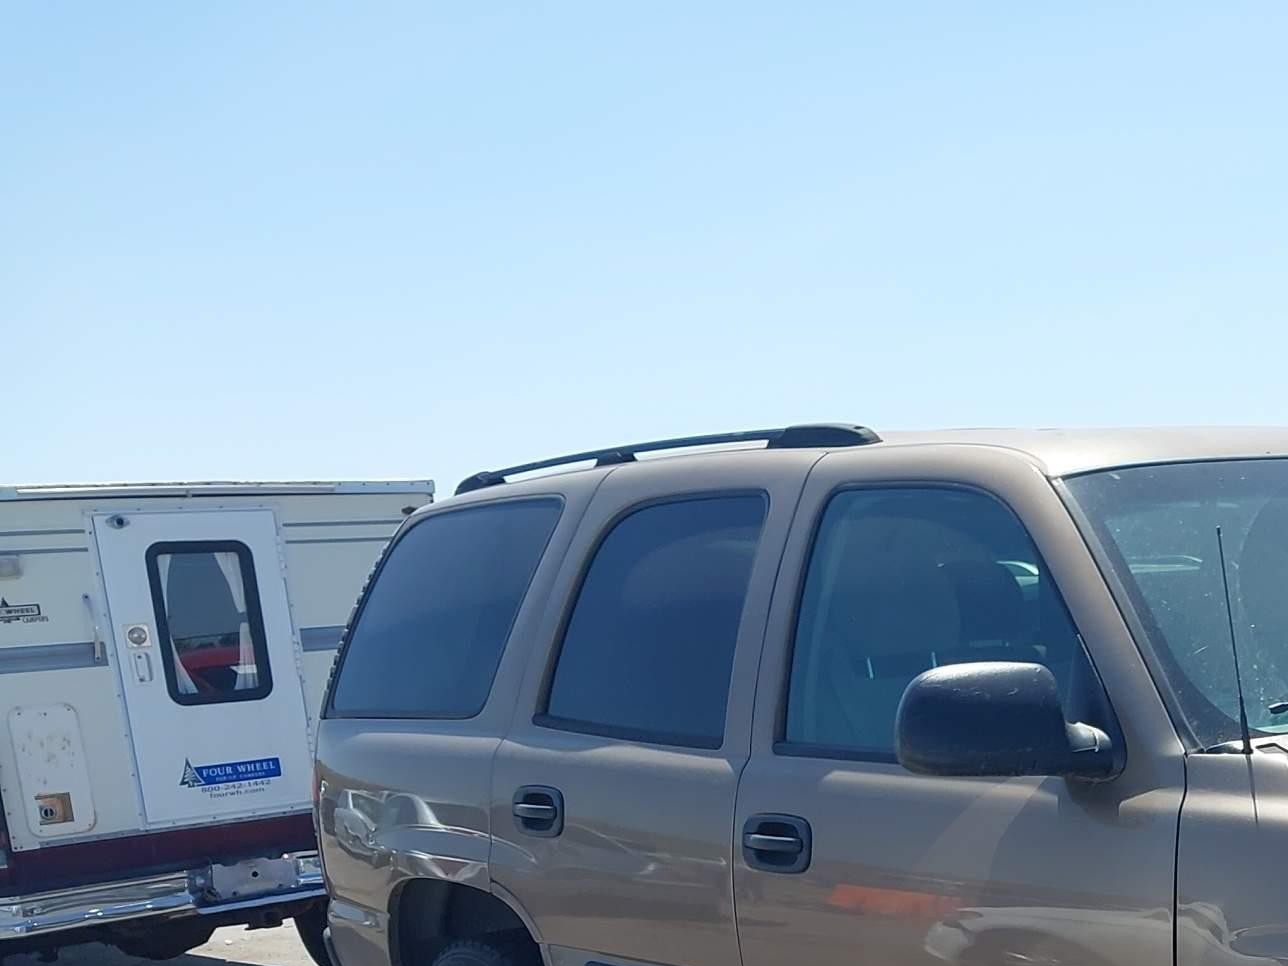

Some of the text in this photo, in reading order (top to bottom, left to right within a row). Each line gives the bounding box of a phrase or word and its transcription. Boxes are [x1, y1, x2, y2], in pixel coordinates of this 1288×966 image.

[202, 761, 276, 777] FOUR WHEEL
[201, 779, 271, 793] 800-242-1442
